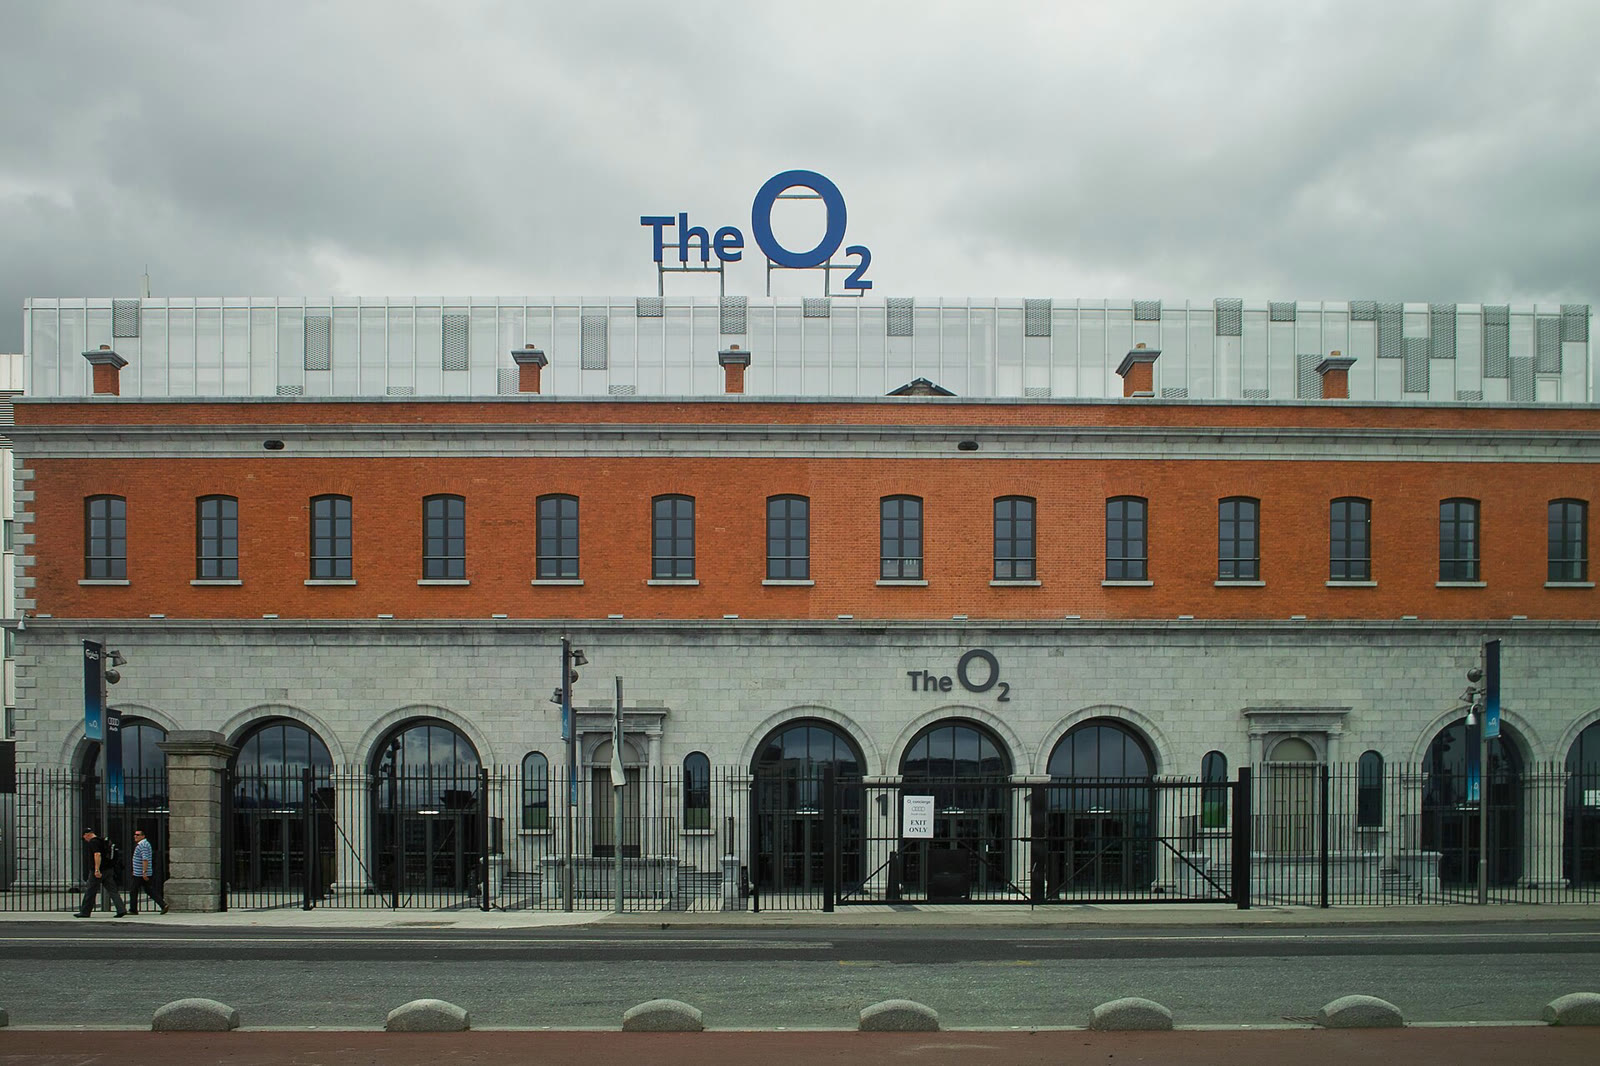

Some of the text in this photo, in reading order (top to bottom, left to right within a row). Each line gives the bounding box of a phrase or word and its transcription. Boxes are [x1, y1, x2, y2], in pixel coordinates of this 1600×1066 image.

[640, 169, 873, 290] The O2
[907, 649, 1010, 702] The O2
